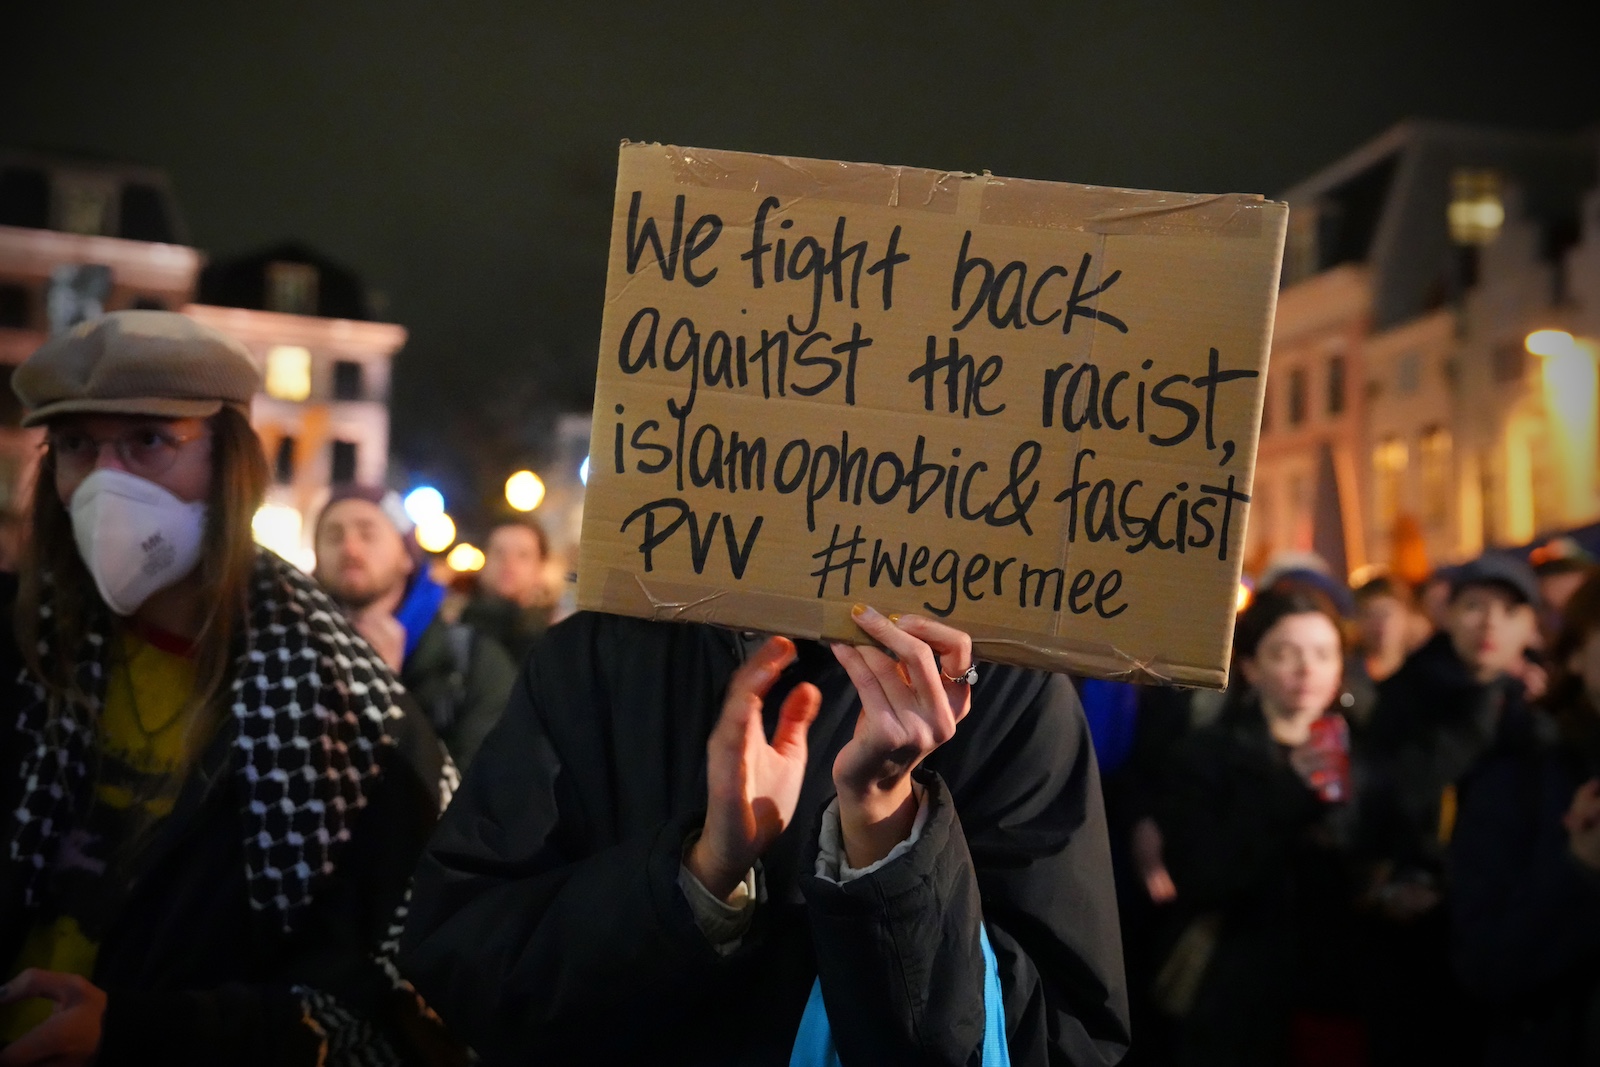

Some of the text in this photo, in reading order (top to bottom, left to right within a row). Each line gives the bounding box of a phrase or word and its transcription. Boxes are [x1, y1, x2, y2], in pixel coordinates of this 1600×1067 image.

[626, 191, 1129, 335] We fight back
[618, 307, 1259, 466] against the racist,
[614, 404, 988, 531] islamophobic
[1054, 448, 1251, 561] fascist
[621, 498, 1129, 618] PVV #wegermee
